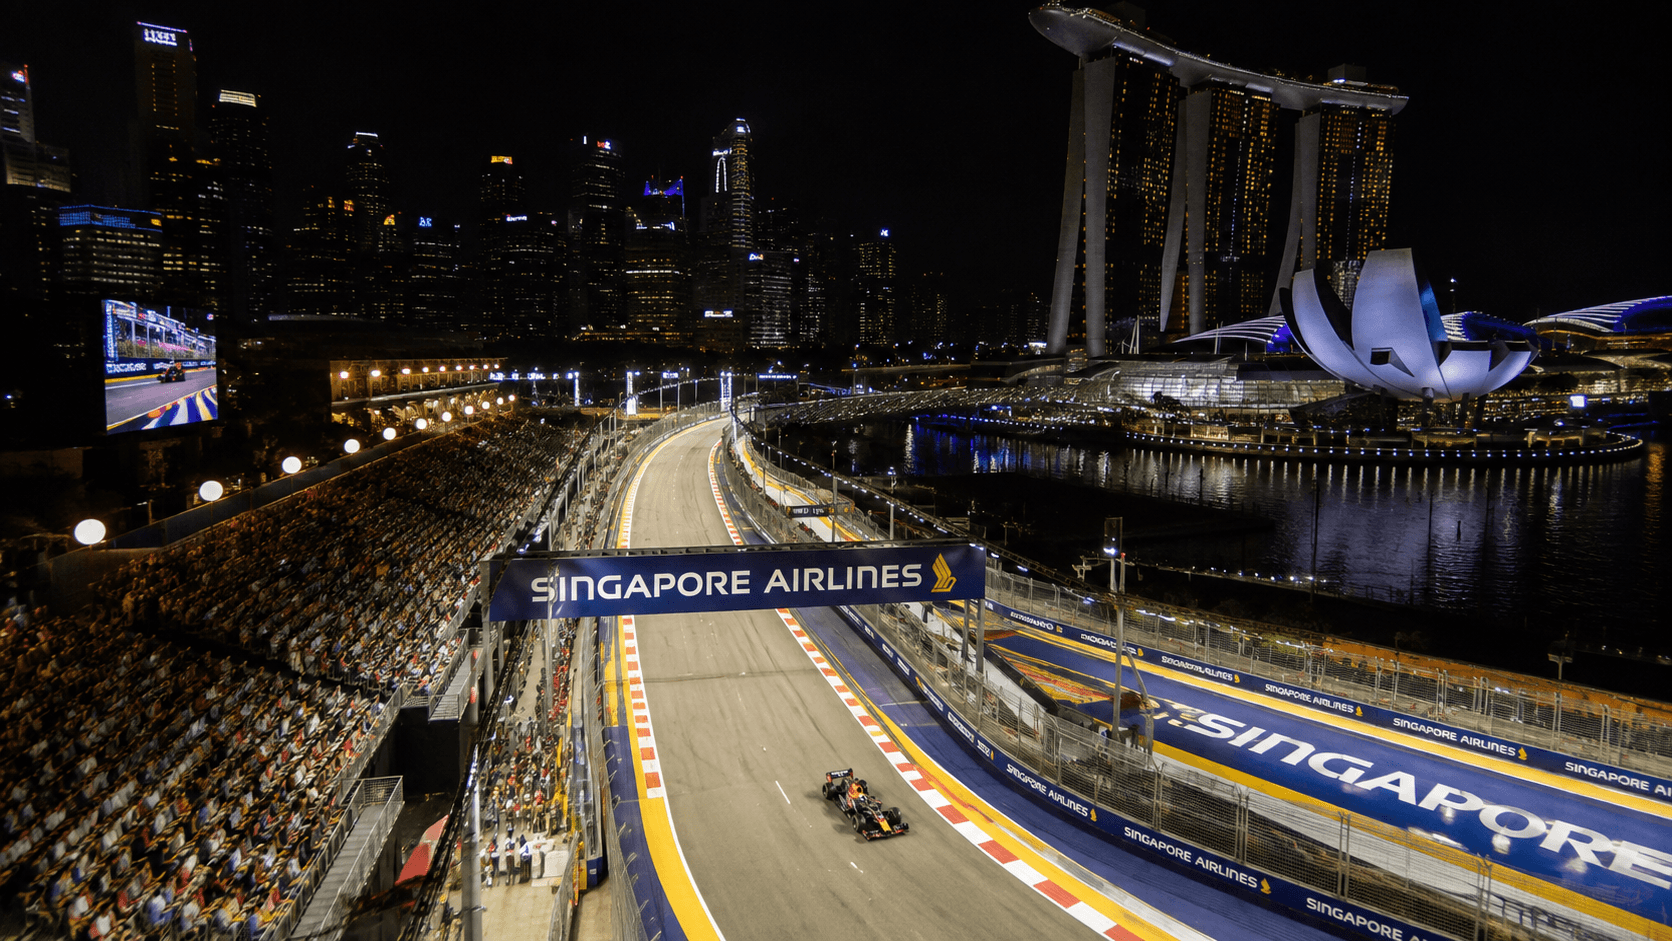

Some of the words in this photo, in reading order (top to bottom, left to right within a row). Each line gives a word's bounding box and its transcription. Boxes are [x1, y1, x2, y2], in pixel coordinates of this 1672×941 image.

[531, 569, 751, 603] SINGAPORE
[763, 563, 923, 594] AIRLINES
[1392, 717, 1457, 742] SINGAPORE
[1460, 734, 1516, 757] AIRLINES
[1564, 761, 1650, 791] SINGAPORE
[1048, 789, 1089, 817] AIRLINES
[1183, 713, 1672, 890] SINGAPORE
[1123, 826, 1192, 863] SINGAPORE
[1194, 856, 1258, 889] AIRLINES
[1306, 897, 1403, 941] SINGAPORE
